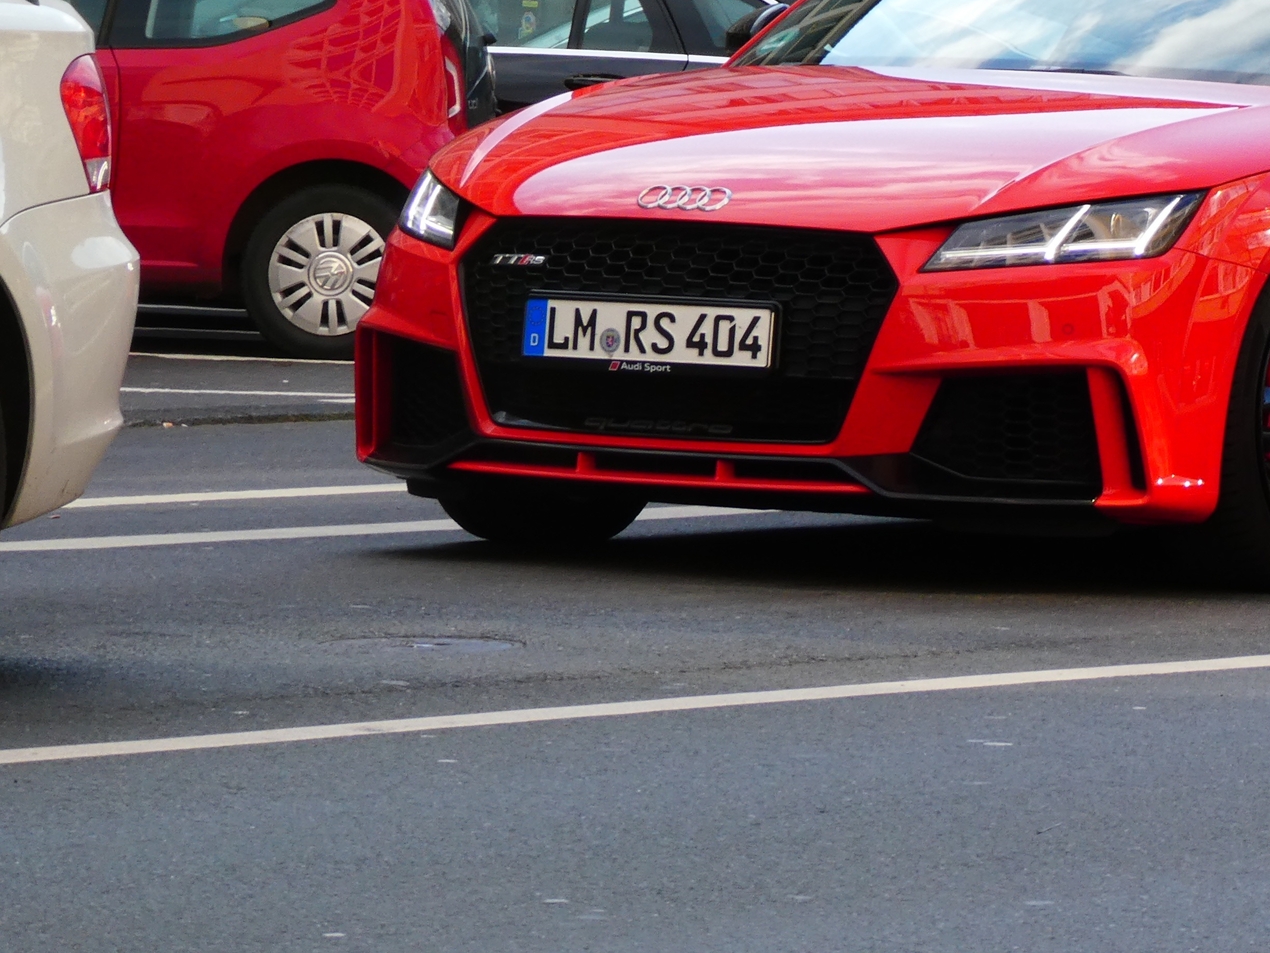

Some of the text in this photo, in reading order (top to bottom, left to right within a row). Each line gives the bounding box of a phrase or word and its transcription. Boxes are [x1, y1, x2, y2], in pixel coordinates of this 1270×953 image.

[530, 306, 762, 360] D LM RS 404
[620, 361, 671, 373] Audi Sport
